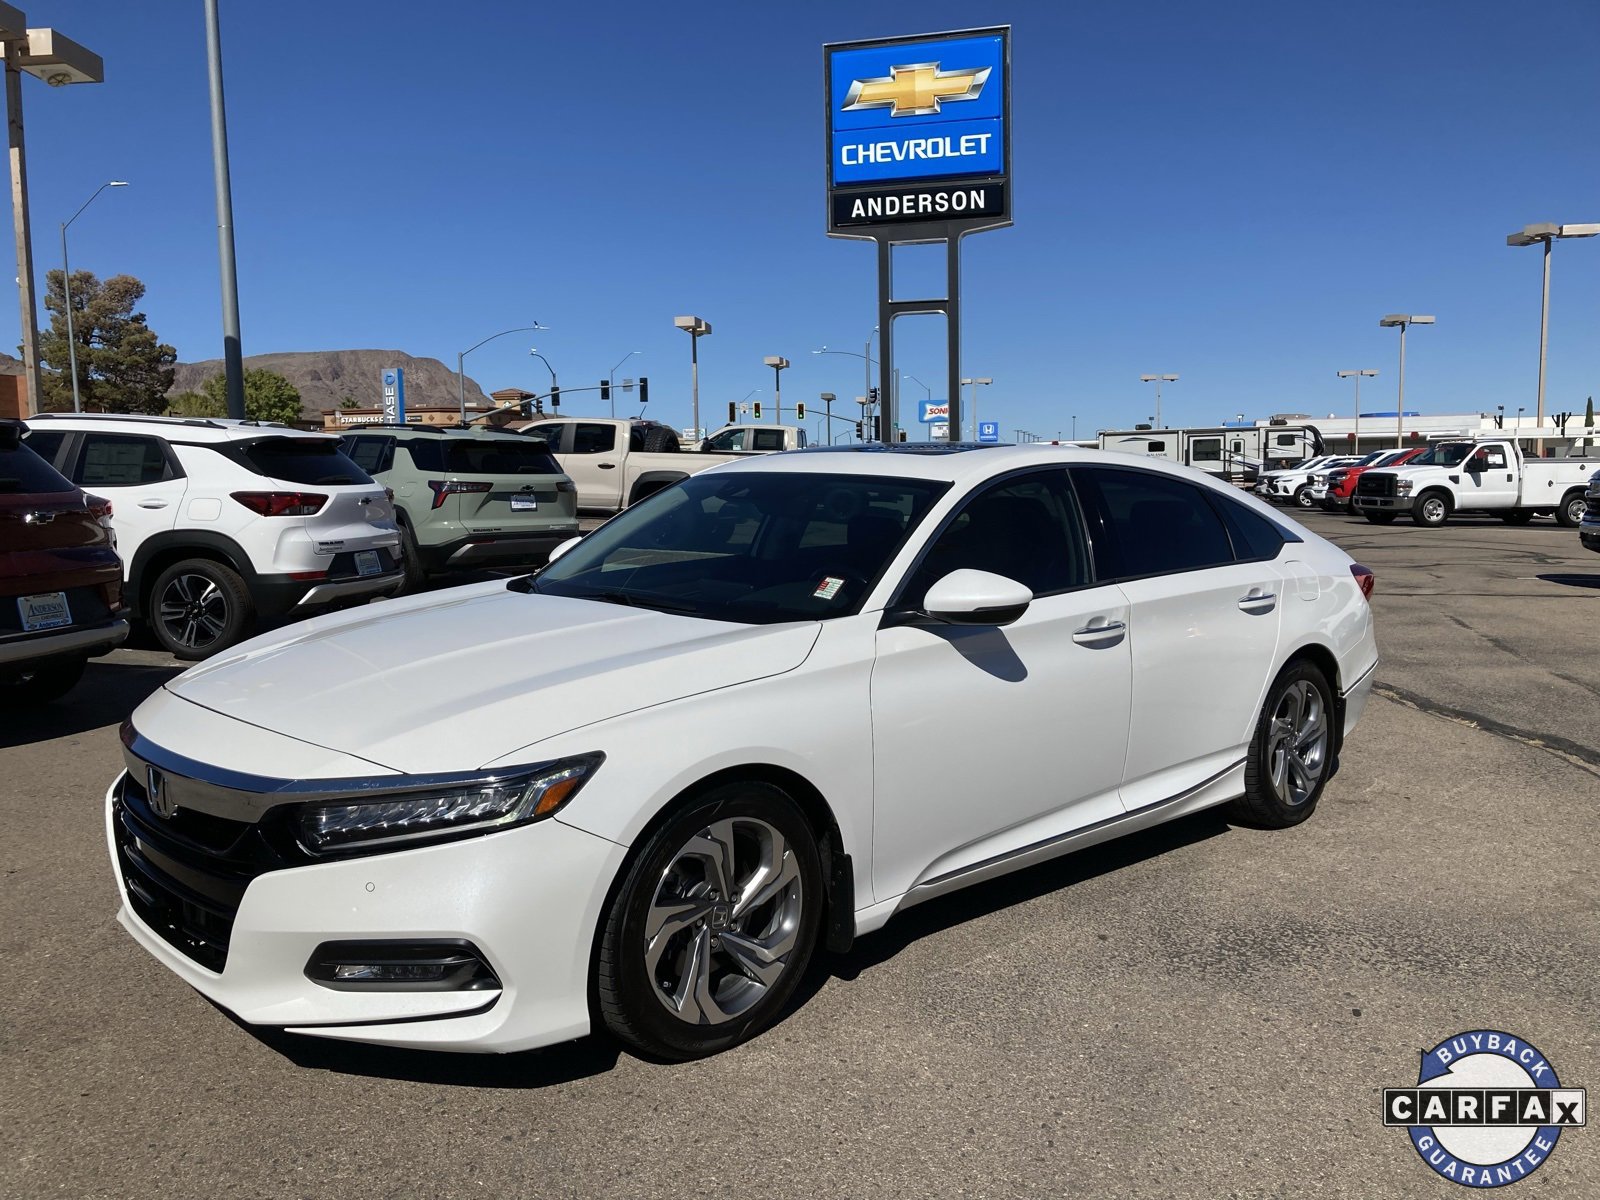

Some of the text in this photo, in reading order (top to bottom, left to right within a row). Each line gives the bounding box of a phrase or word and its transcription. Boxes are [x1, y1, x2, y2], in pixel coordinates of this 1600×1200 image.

[841, 133, 992, 165] CHEVROLET
[851, 189, 986, 218] ANDERSON
[385, 387, 396, 428] HASE
[928, 407, 949, 415] SONI
[28, 602, 65, 617] ANDERSON
